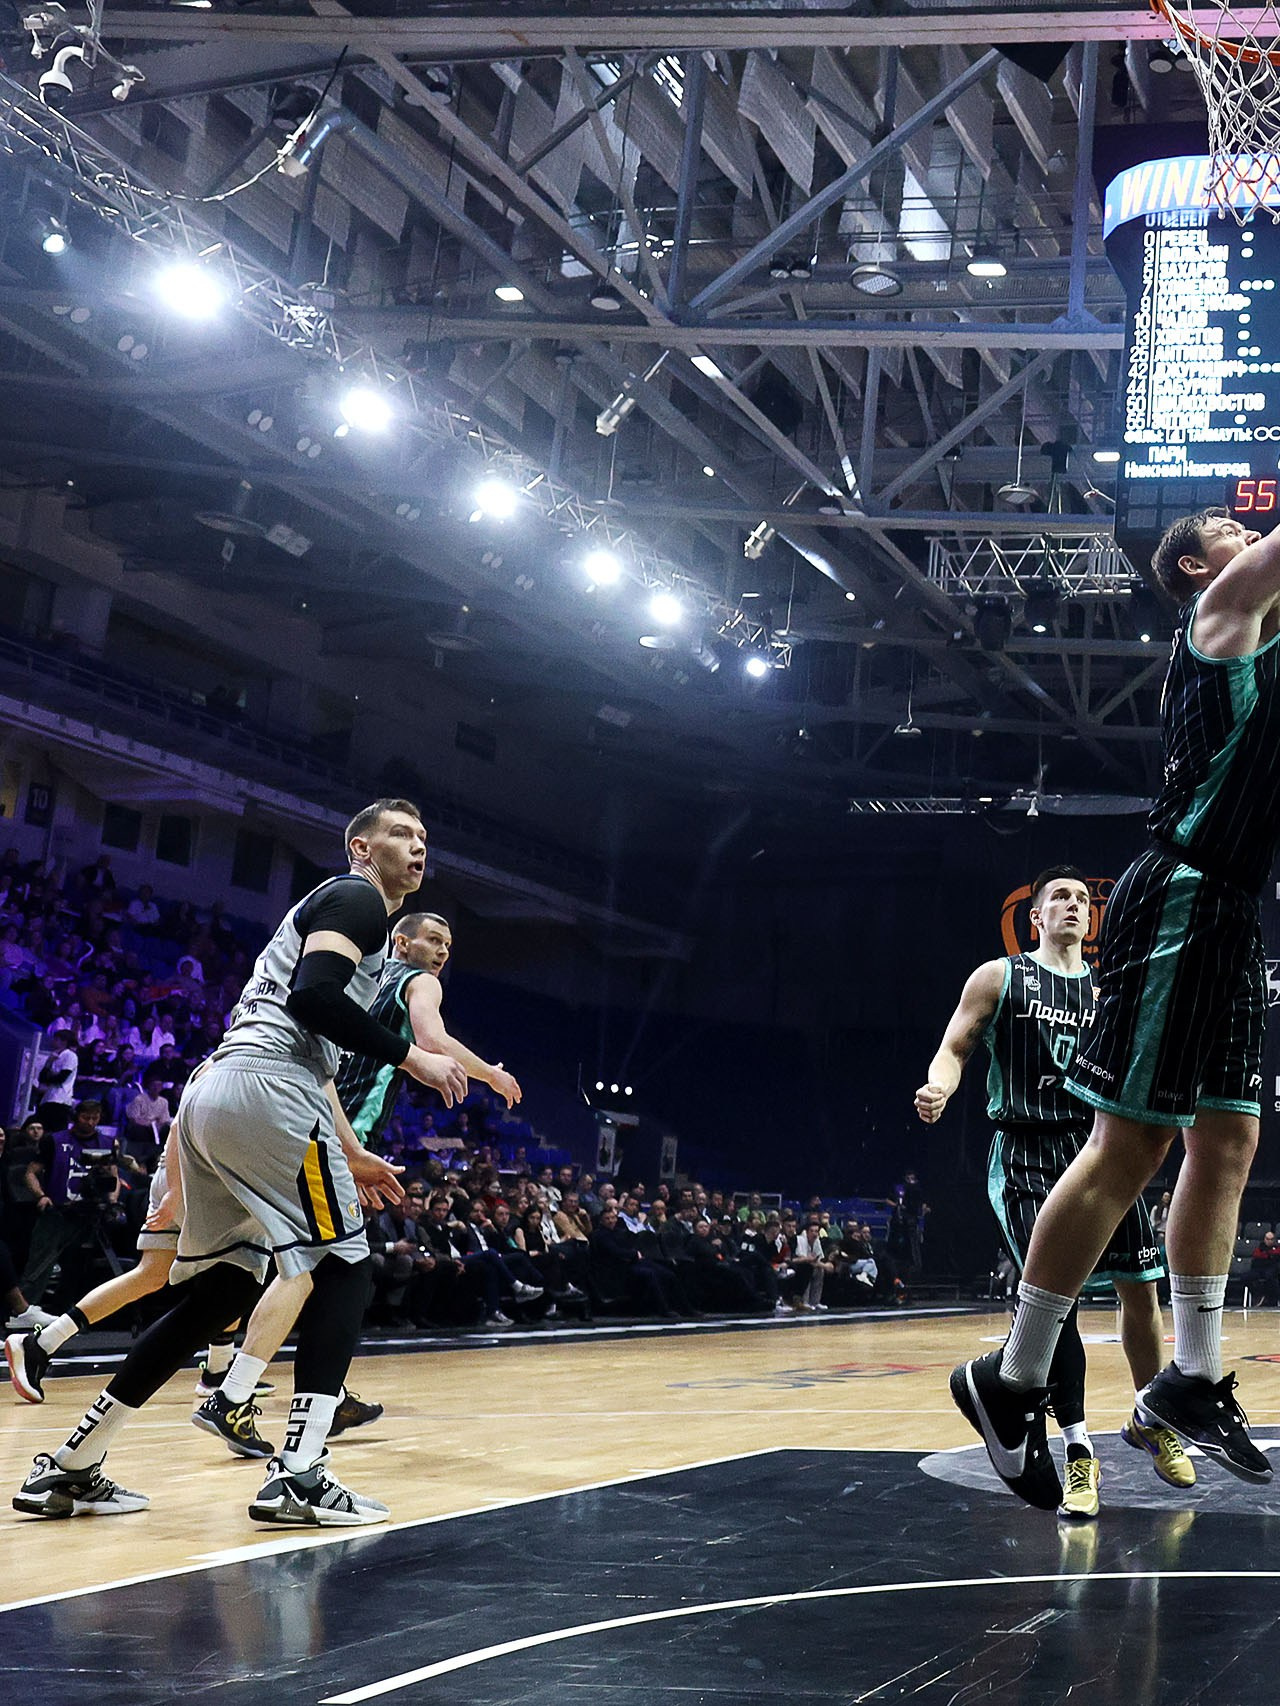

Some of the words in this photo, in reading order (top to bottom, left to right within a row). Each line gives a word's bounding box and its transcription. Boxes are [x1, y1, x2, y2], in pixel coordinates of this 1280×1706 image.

[1144, 231, 1155, 247] 0
[1143, 247, 1155, 262] 3
[1143, 263, 1154, 280] 5
[1143, 279, 1153, 296] 7
[1134, 312, 1150, 329] 10
[1134, 329, 1150, 346] 13
[1128, 362, 1148, 378] 42
[1126, 379, 1147, 395] 44
[1126, 396, 1147, 412] 50
[1126, 412, 1146, 430] 55
[1235, 480, 1276, 511] 55
[1054, 1034, 1076, 1071] 0
[65, 1396, 113, 1450] ELITE
[283, 1397, 313, 1452] ELITE
